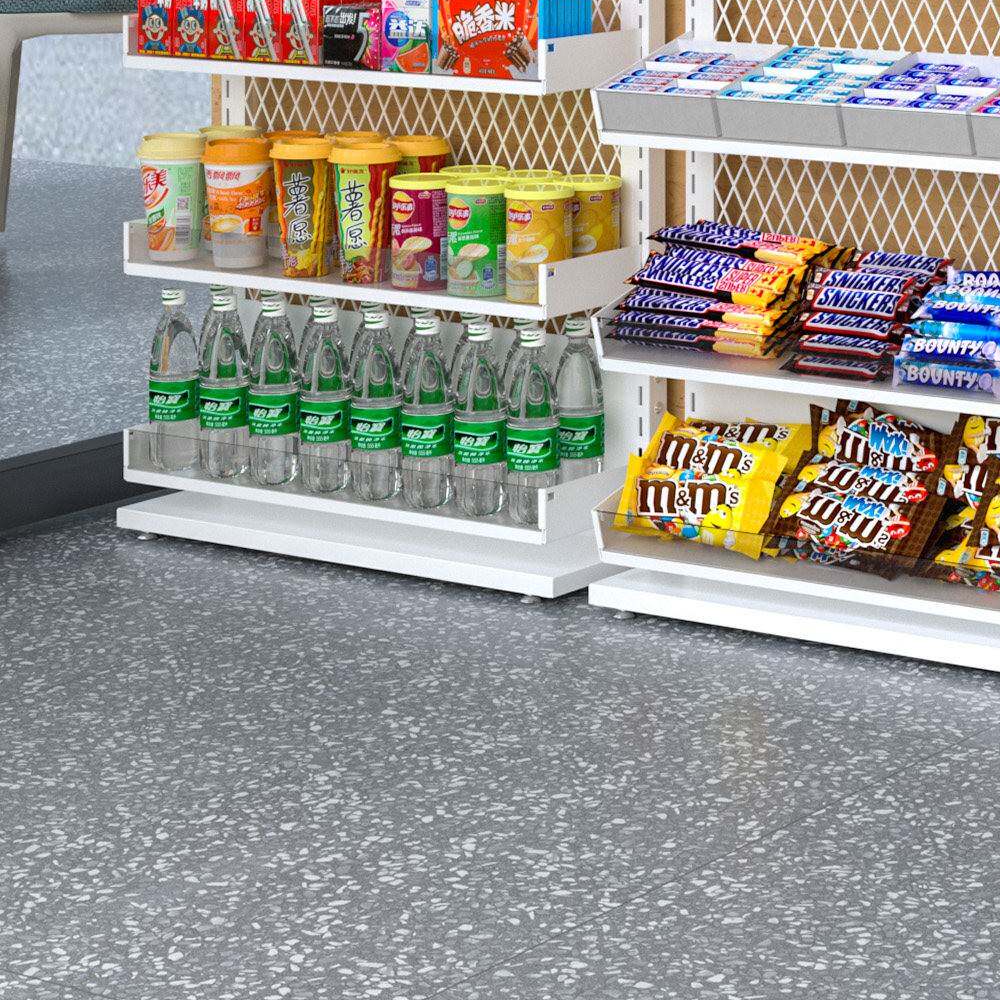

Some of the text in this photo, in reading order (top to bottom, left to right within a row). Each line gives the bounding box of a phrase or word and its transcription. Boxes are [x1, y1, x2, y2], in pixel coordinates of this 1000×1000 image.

[452, 0, 516, 44] 脆香米
[864, 251, 941, 273] SNICKERS
[724, 269, 760, 286] SUPER
[826, 270, 906, 294] SNICKERS
[819, 289, 901, 314] SNICKERS
[812, 312, 893, 334] SNICKERS
[914, 338, 983, 357] BOUNTY
[906, 366, 978, 390] BOUNTY
[657, 432, 755, 477] m&m's
[637, 479, 741, 516] m&m's
